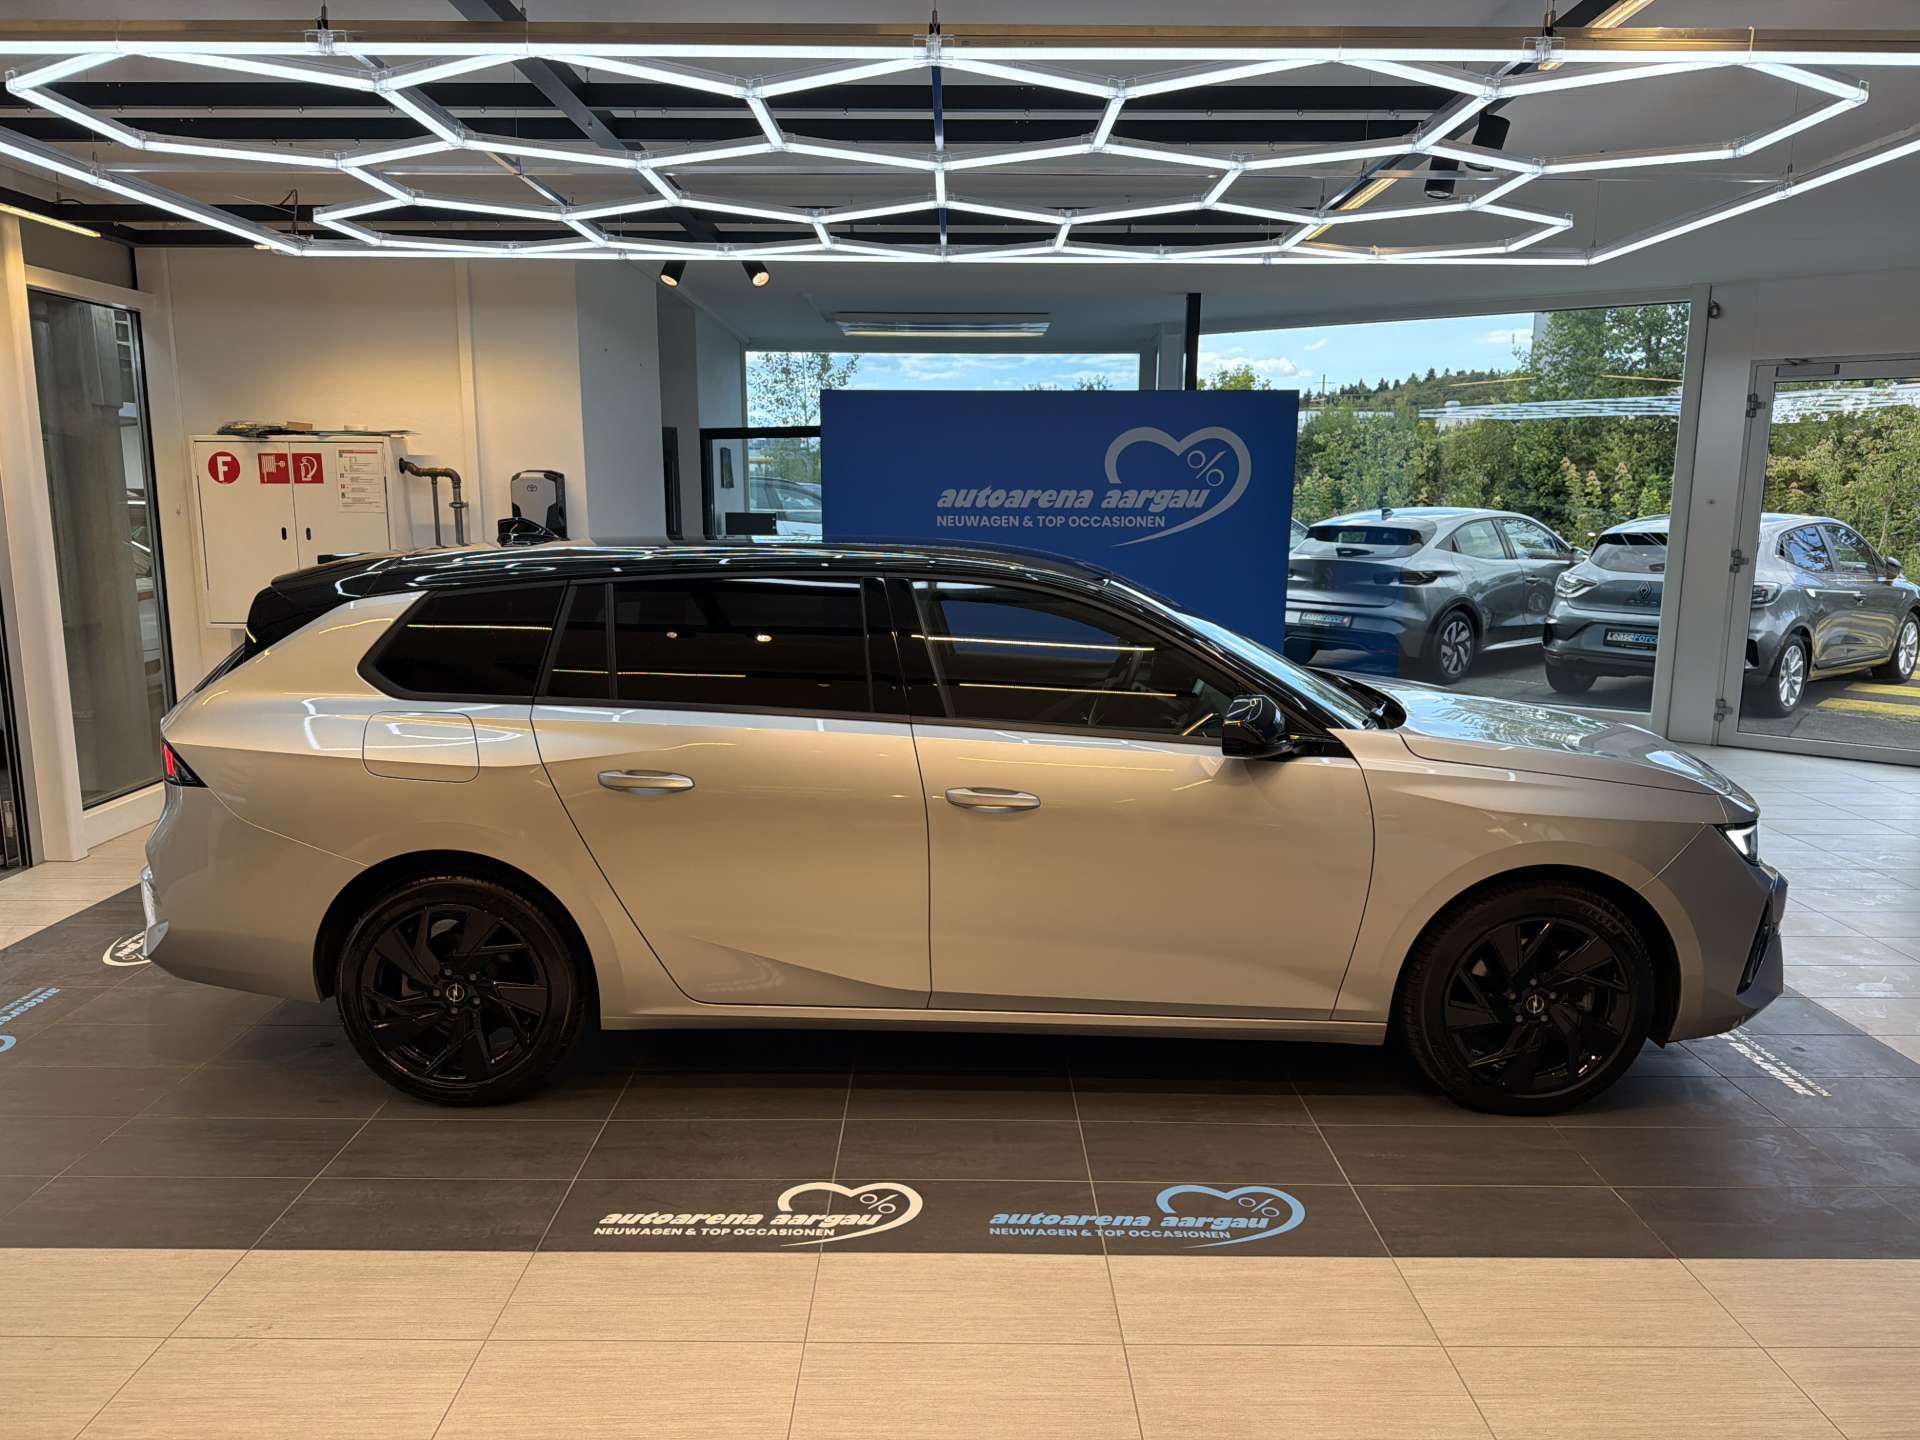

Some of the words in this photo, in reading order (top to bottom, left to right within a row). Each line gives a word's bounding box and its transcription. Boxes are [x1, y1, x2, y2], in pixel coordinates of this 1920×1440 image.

[217, 456, 233, 481] F
[937, 486, 1094, 508] autoarena
[1101, 489, 1210, 513] aargau
[936, 515, 1019, 527] NEUWAGEN
[1022, 516, 1033, 527] &
[1037, 516, 1065, 527] TOP
[1068, 516, 1165, 528] OCCASIONEN
[599, 1211, 764, 1225] autoarena
[770, 1213, 883, 1228] aargau
[989, 1212, 1151, 1227] autoarena
[1159, 1216, 1271, 1231] aargau
[593, 1227, 682, 1236] NEUWAGEN
[685, 1228, 697, 1236] &
[700, 1228, 730, 1236] TOP
[733, 1228, 835, 1237] OCCASIONEN
[989, 1227, 1077, 1237] NEUWAGEN
[1080, 1229, 1092, 1237] &
[1095, 1229, 1125, 1238] TOP
[1128, 1229, 1231, 1239] OCCASIONEN
